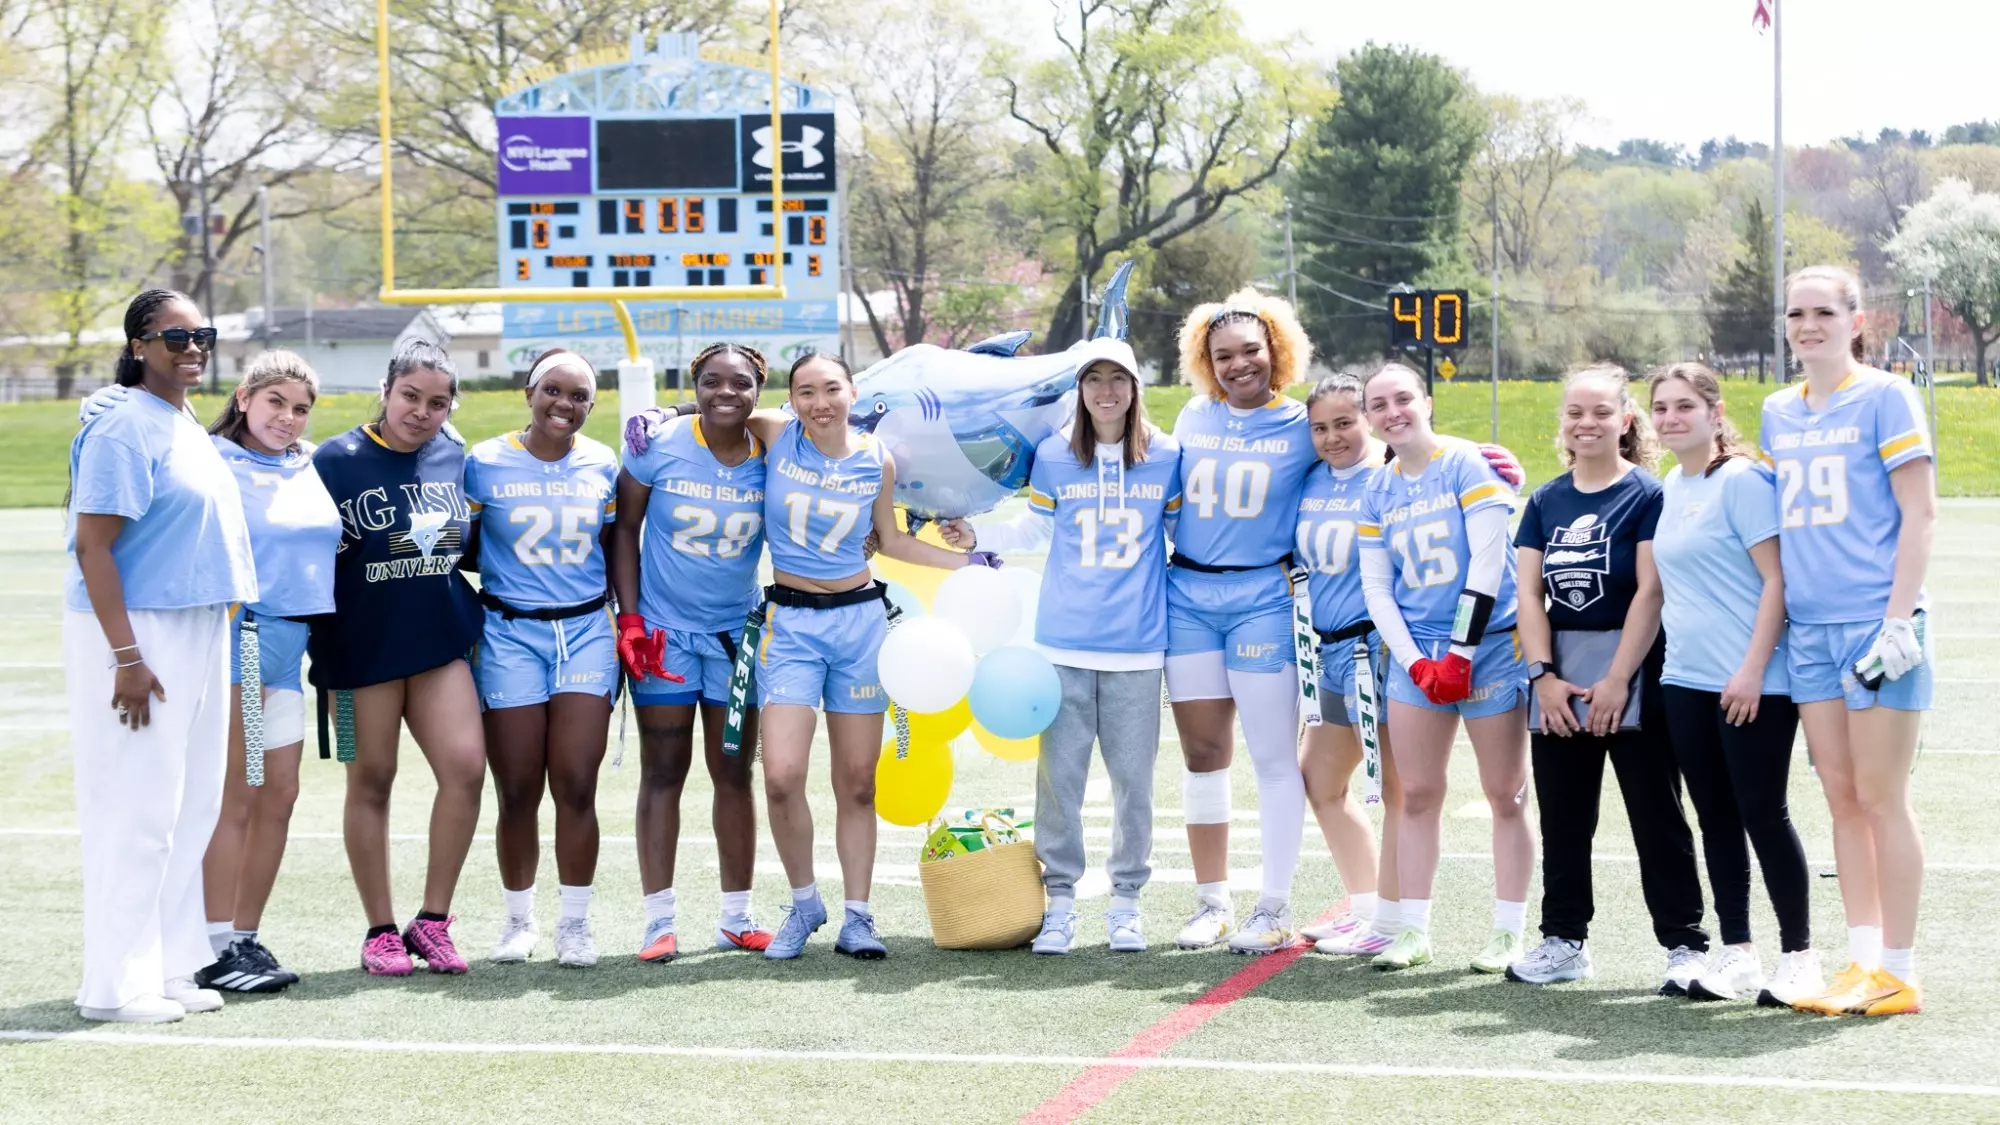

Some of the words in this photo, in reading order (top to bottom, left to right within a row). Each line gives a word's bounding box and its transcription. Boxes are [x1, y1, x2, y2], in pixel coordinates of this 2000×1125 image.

[533, 220, 549, 248] 0
[809, 216, 825, 244] 0
[517, 257, 530, 280] 3
[808, 254, 821, 276] 3
[638, 308, 670, 331] GO
[679, 306, 784, 332] SHARKS!
[1394, 294, 1461, 343] 40
[1222, 436, 1289, 454] ISLAND
[1802, 426, 1860, 447] ISLAND
[664, 478, 713, 500] LONG
[776, 457, 820, 487] LONG
[820, 474, 879, 495] ISLAND
[1185, 457, 1271, 519] 40
[492, 482, 542, 499] LONG
[1056, 482, 1098, 500] LONG
[1776, 454, 1849, 529] 29
[509, 505, 599, 565] 25
[672, 503, 762, 559] 28
[783, 491, 860, 554] 17
[1074, 507, 1143, 569] 13
[1296, 519, 1356, 576] 10
[1560, 530, 1592, 544] 2025
[1390, 519, 1458, 589] 15
[366, 554, 464, 583] UNIVERS
[1558, 580, 1592, 590] CHALLENGE
[1236, 643, 1261, 658] LIU
[1296, 605, 1317, 701] J-E-T-S
[727, 632, 755, 733] J-E-T-S
[849, 684, 876, 699] LIU
